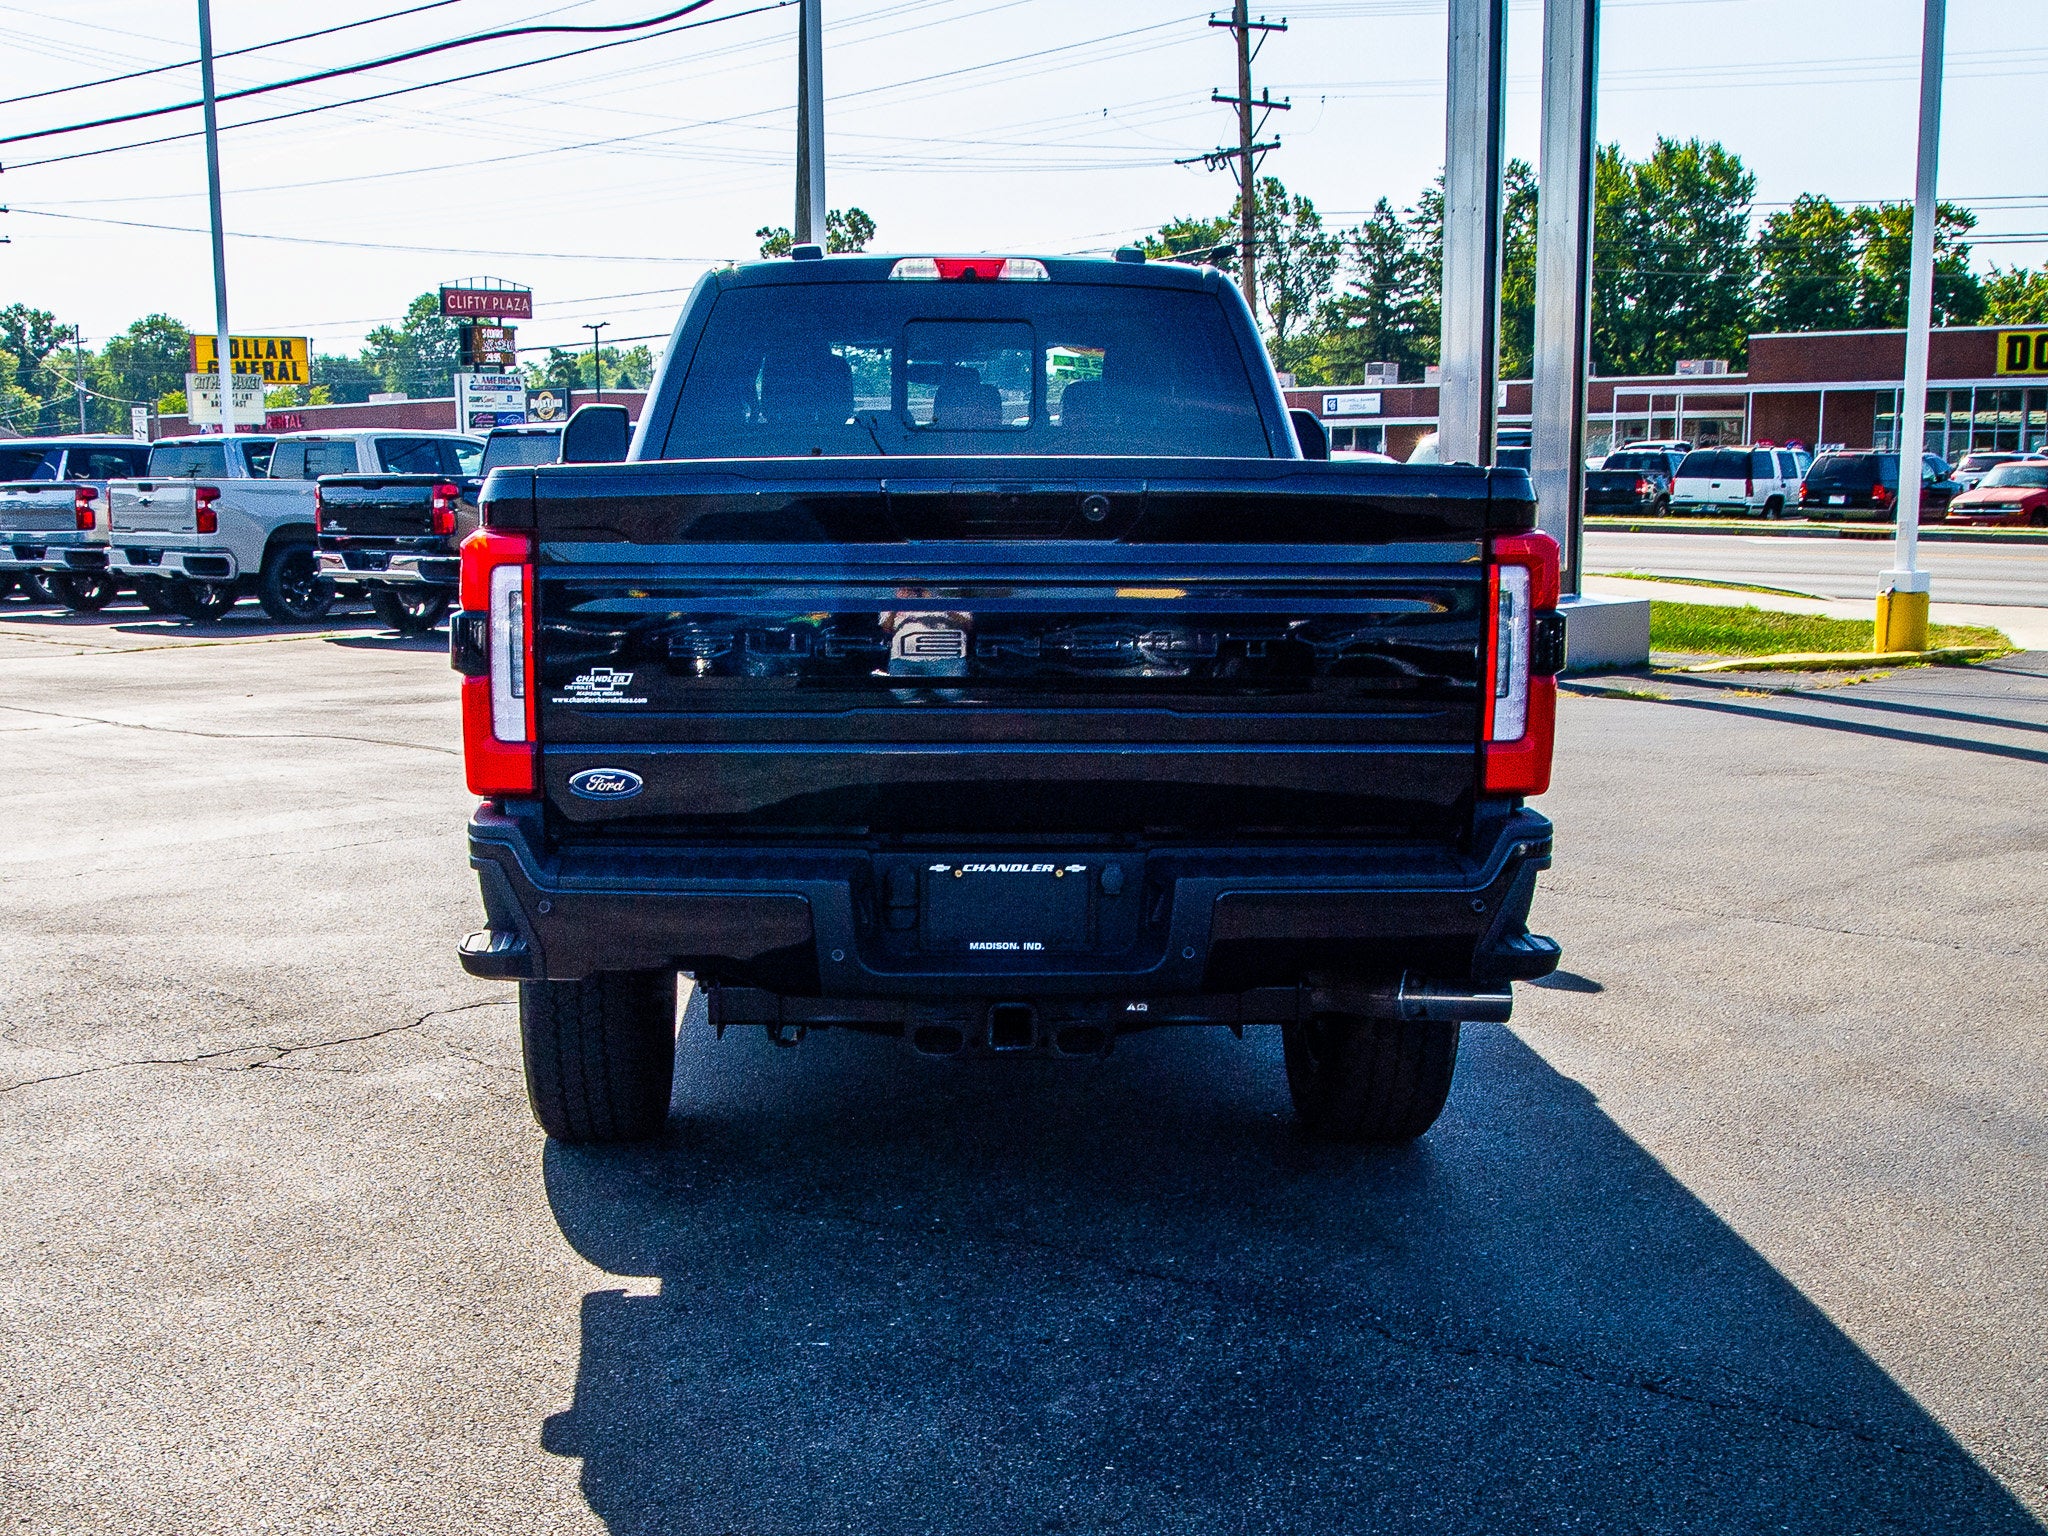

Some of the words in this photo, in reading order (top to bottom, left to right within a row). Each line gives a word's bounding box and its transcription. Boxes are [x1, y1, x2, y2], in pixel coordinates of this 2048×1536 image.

[447, 295, 487, 309] CLIFTY
[493, 297, 529, 311] PLAZA
[207, 360, 301, 381] GNERAL
[481, 376, 521, 385] AMERICAN
[576, 675, 626, 683] CHANDLER
[586, 774, 625, 791] Ford
[962, 864, 1055, 872] CHANDLER
